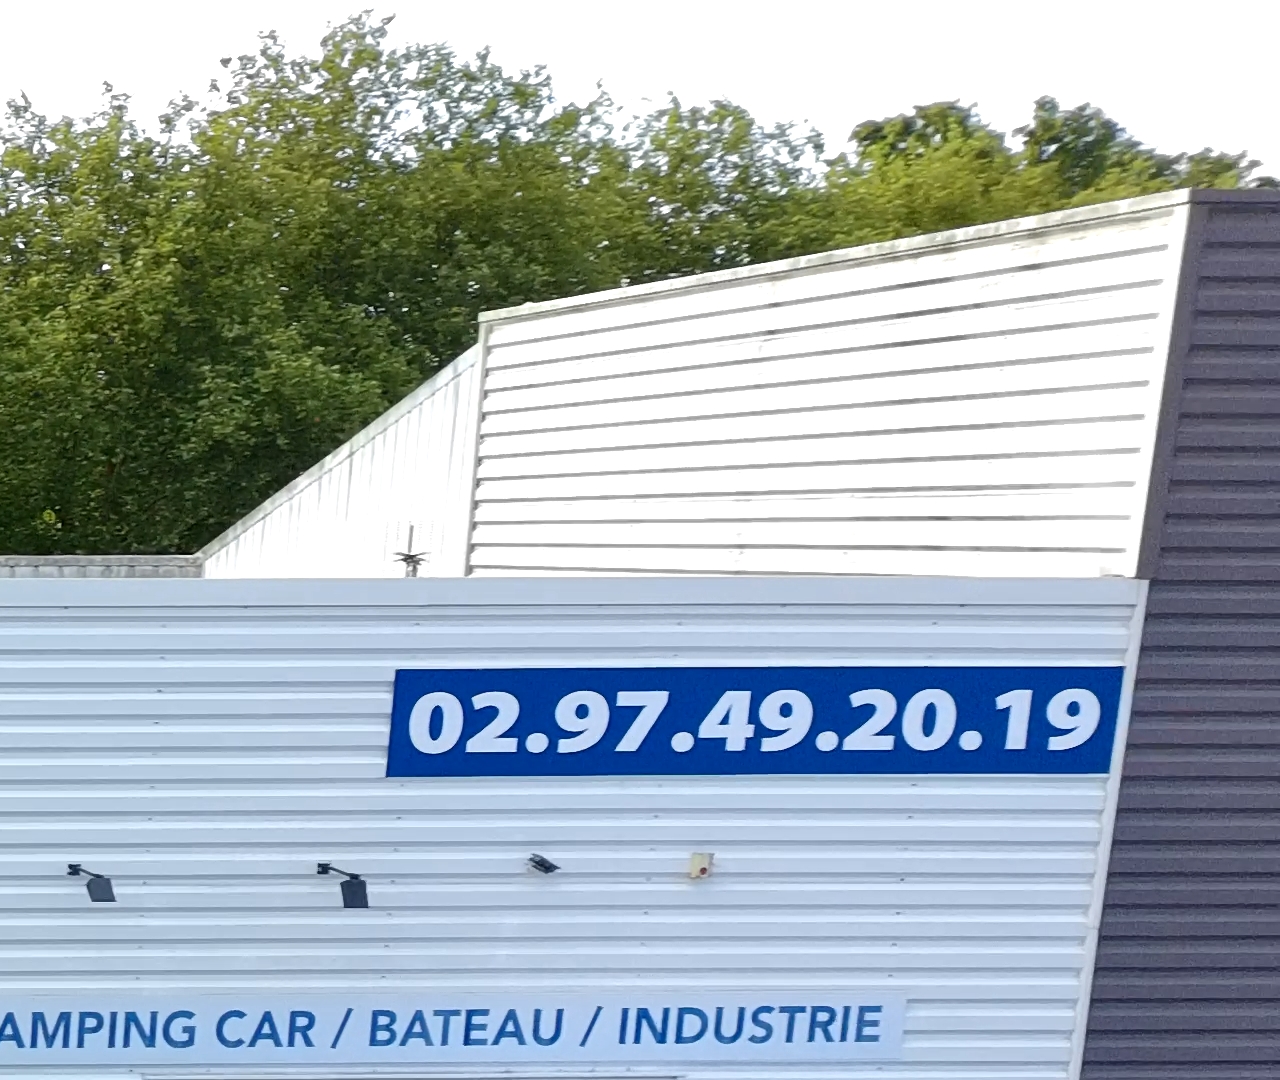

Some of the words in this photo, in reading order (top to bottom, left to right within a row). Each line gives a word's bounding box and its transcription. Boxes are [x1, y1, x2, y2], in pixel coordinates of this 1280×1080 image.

[407, 688, 1102, 756] 02.97.49.20.19
[214, 1010, 316, 1049] CAR
[330, 1008, 353, 1050] /
[368, 1008, 563, 1048] BATEAU
[580, 1006, 601, 1049] /
[618, 1005, 883, 1046] INDUSTRIE
